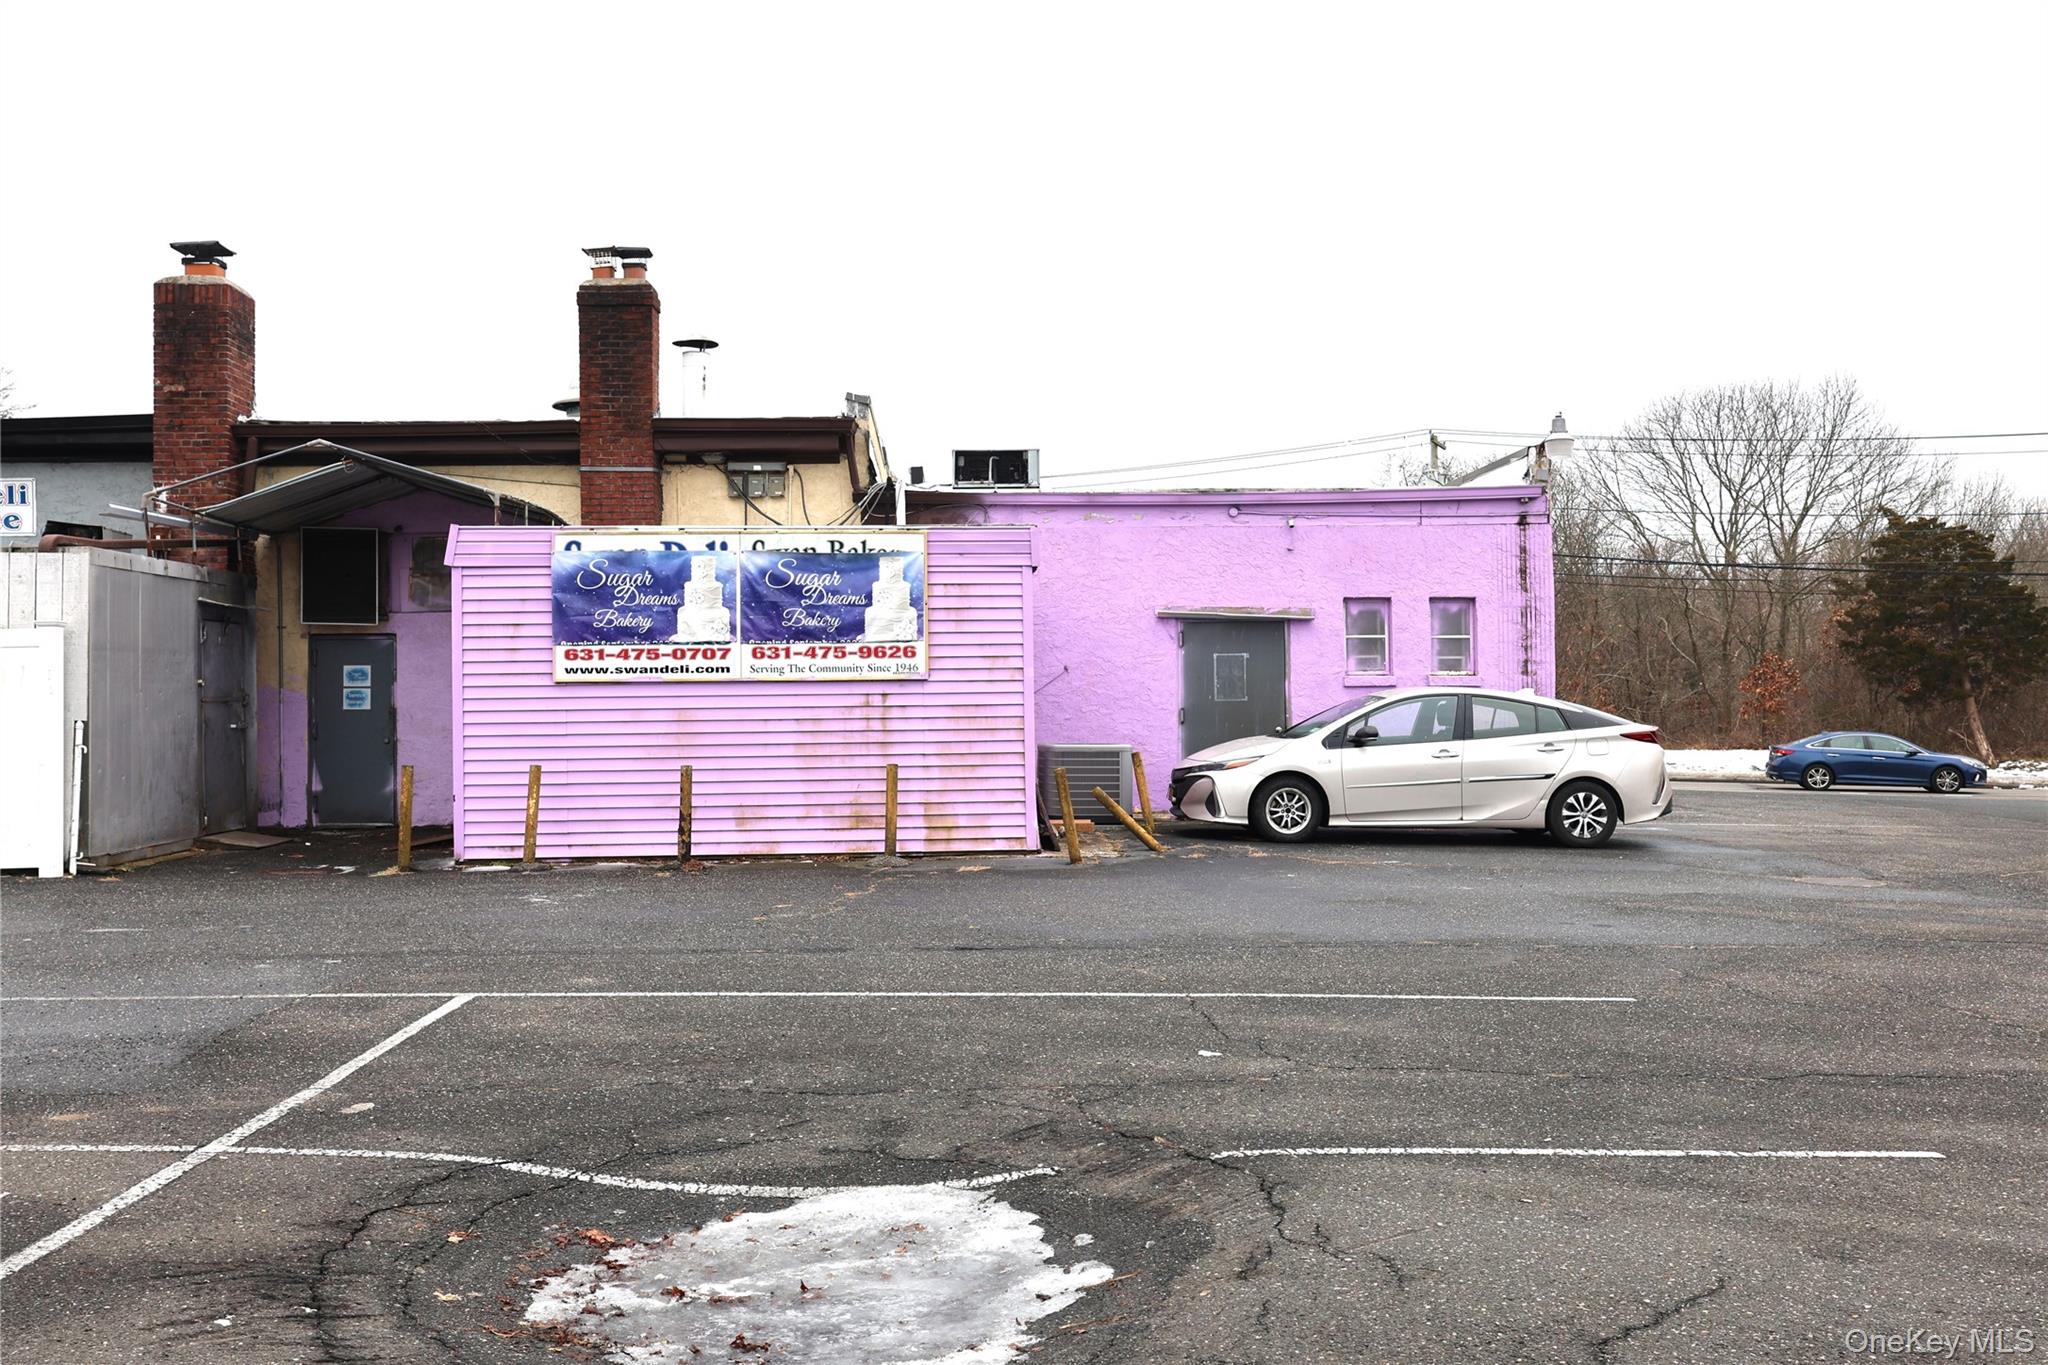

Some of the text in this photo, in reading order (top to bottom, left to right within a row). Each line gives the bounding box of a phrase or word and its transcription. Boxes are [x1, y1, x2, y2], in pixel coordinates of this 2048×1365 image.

[0, 485, 27, 504] li
[577, 559, 654, 597] Sugar
[765, 558, 842, 595] Sugar
[613, 586, 680, 607] Dreams
[800, 585, 868, 607] Dreams
[593, 609, 654, 633] Bakery
[782, 608, 841, 632] Bakery
[564, 648, 731, 661] 631-475-0707
[751, 646, 917, 660] 631-475-9626
[564, 664, 731, 674] www.swandeli.com
[749, 663, 919, 677] Serving The Community Since 1946
